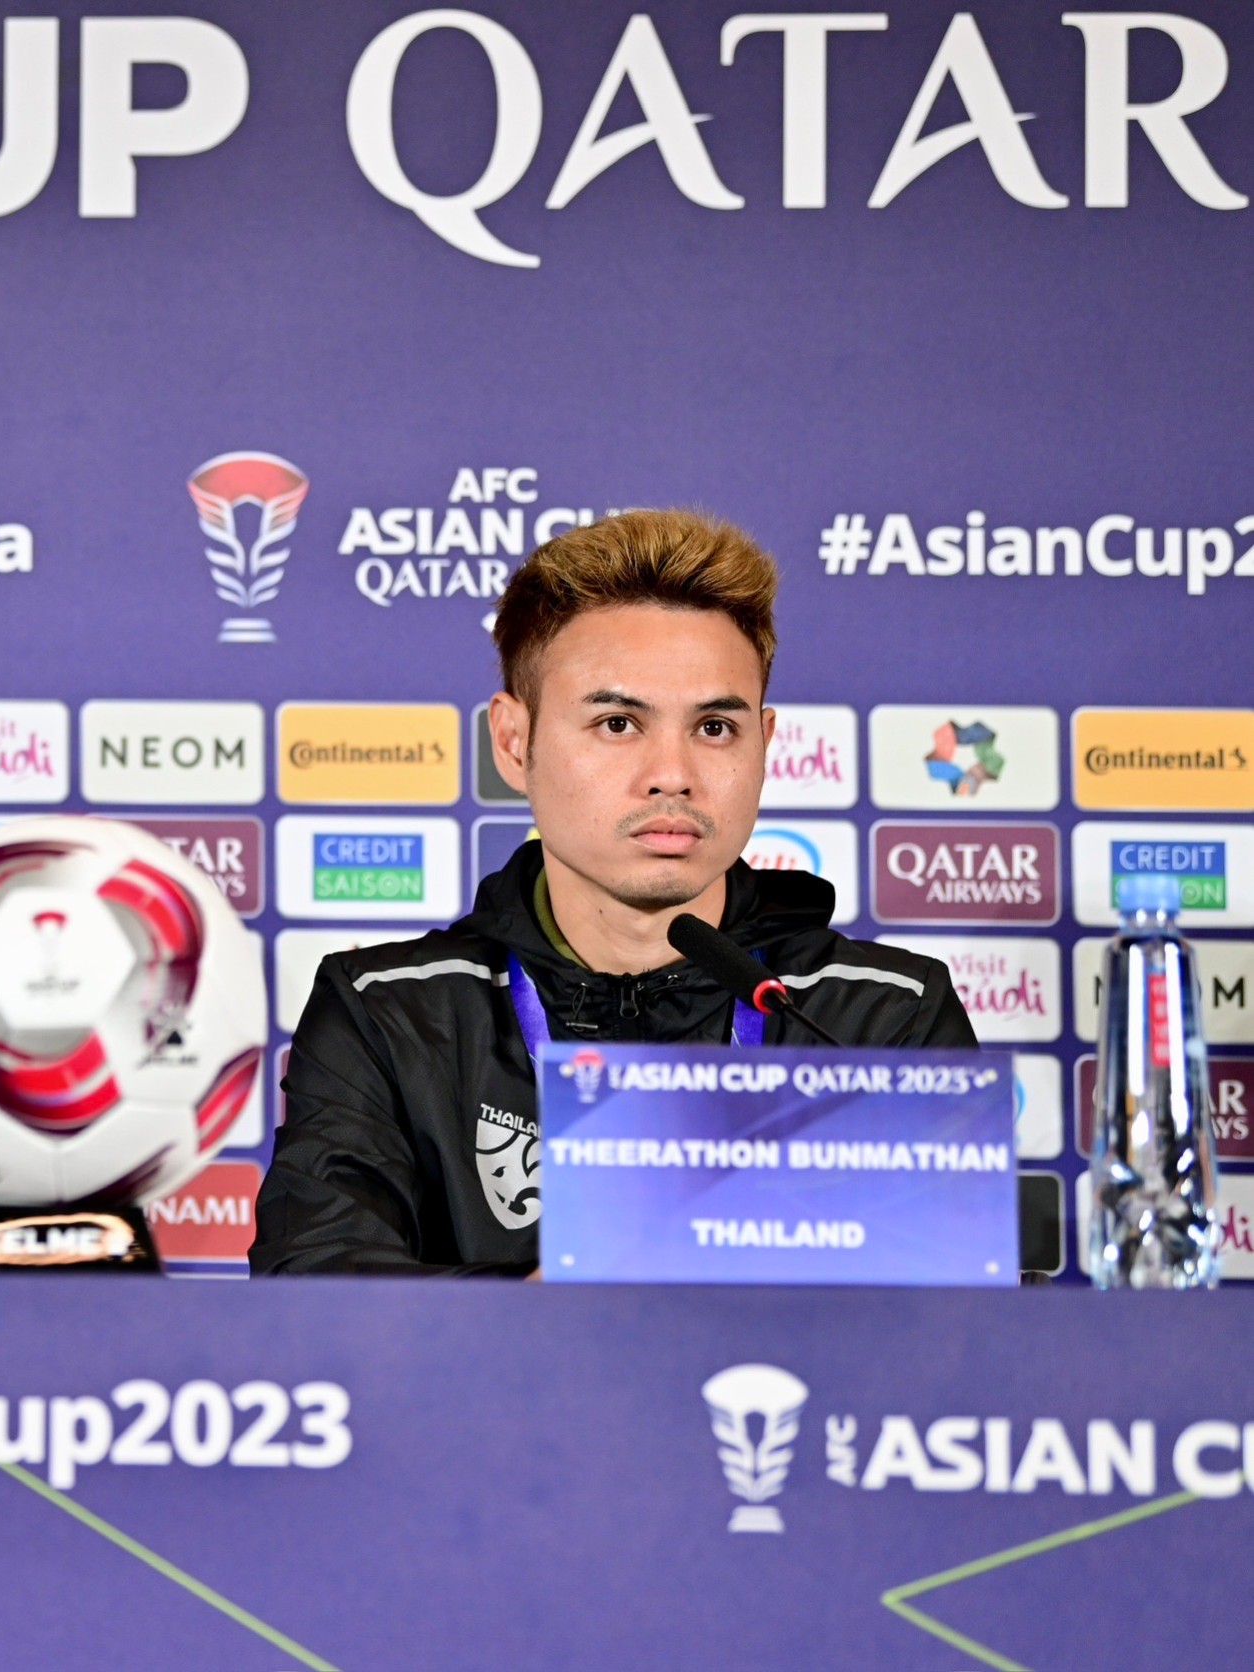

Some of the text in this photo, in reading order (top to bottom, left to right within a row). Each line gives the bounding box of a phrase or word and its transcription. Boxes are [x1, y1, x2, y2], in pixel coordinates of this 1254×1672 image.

[346, 8, 1250, 268] QATAR
[448, 468, 537, 503] AFC
[338, 508, 524, 555] ASIAN
[354, 556, 509, 608] QATAR
[100, 736, 246, 769] NEOM
[288, 739, 424, 769] Continental
[1084, 745, 1226, 776] Continental
[320, 839, 417, 866] CREDIT
[887, 842, 1040, 887] QATAR
[1118, 844, 1217, 871] CREDIT
[316, 870, 423, 899] SAISON
[925, 880, 1042, 904] AIRWAYS
[950, 954, 1008, 977] Visit
[622, 1062, 719, 1092] ASIAN
[721, 1063, 788, 1092] CUP
[793, 1066, 892, 1098] QATAR
[480, 1103, 542, 1138] THAILA
[548, 1138, 1008, 1172] THEERATHON BUNMATHAN
[144, 1194, 250, 1227] NAMI
[691, 1219, 866, 1249] THAILAND
[861, 1415, 1254, 1500] ASIAN C
